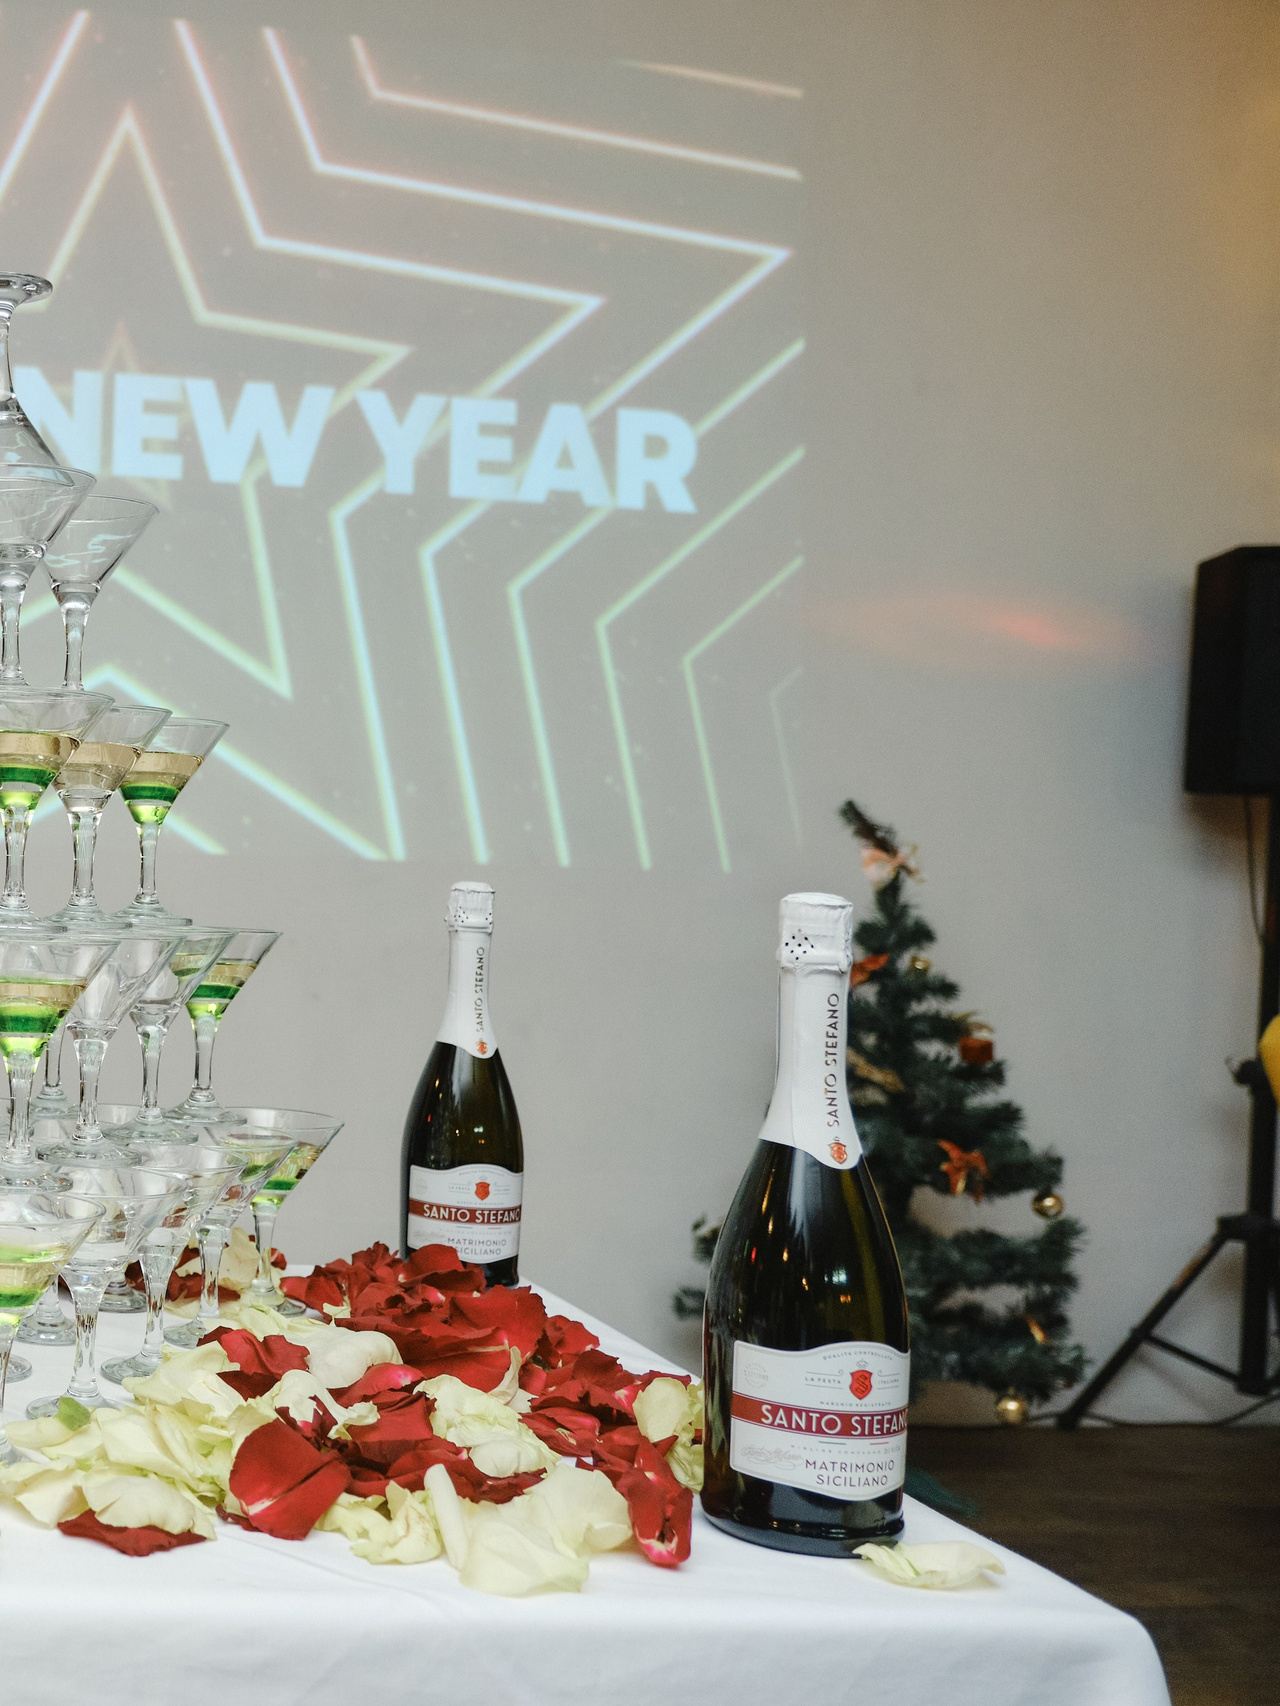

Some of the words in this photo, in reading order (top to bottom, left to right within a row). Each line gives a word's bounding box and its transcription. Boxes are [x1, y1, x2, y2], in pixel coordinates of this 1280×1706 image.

[12, 365, 332, 487] NEW
[356, 389, 699, 514] YEAR
[475, 947, 485, 994] STEFANO
[474, 998, 485, 1032] SANTO
[825, 993, 840, 1066] STEFANO
[824, 1073, 840, 1128] SANTO
[423, 1204, 470, 1222] SANTO
[447, 1238, 507, 1247] MATRIMONIO
[761, 1405, 842, 1434] SANTO
[805, 1459, 895, 1473] MATRIMONIO
[816, 1474, 889, 1487] SICILIANO
